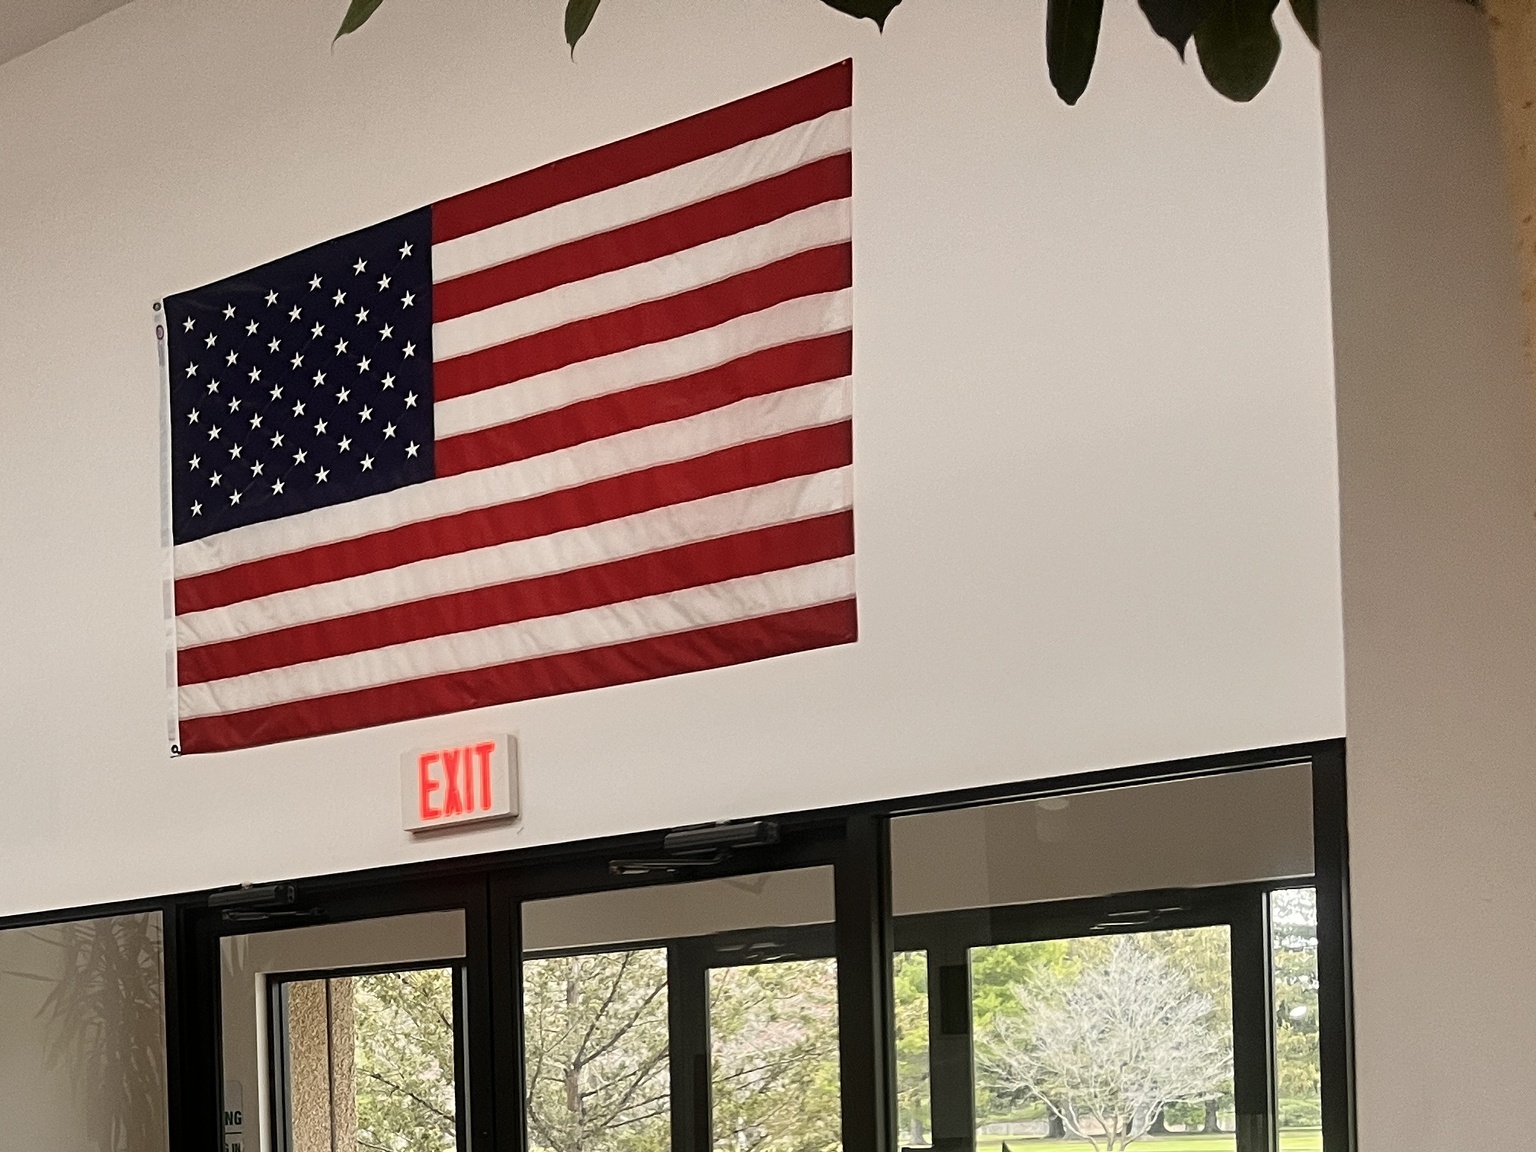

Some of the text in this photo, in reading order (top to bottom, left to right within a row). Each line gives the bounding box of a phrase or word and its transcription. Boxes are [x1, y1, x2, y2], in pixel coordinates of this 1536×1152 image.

[418, 741, 495, 820] EXIT
[224, 1110, 242, 1125] NG
[231, 1143, 241, 1152] IN
